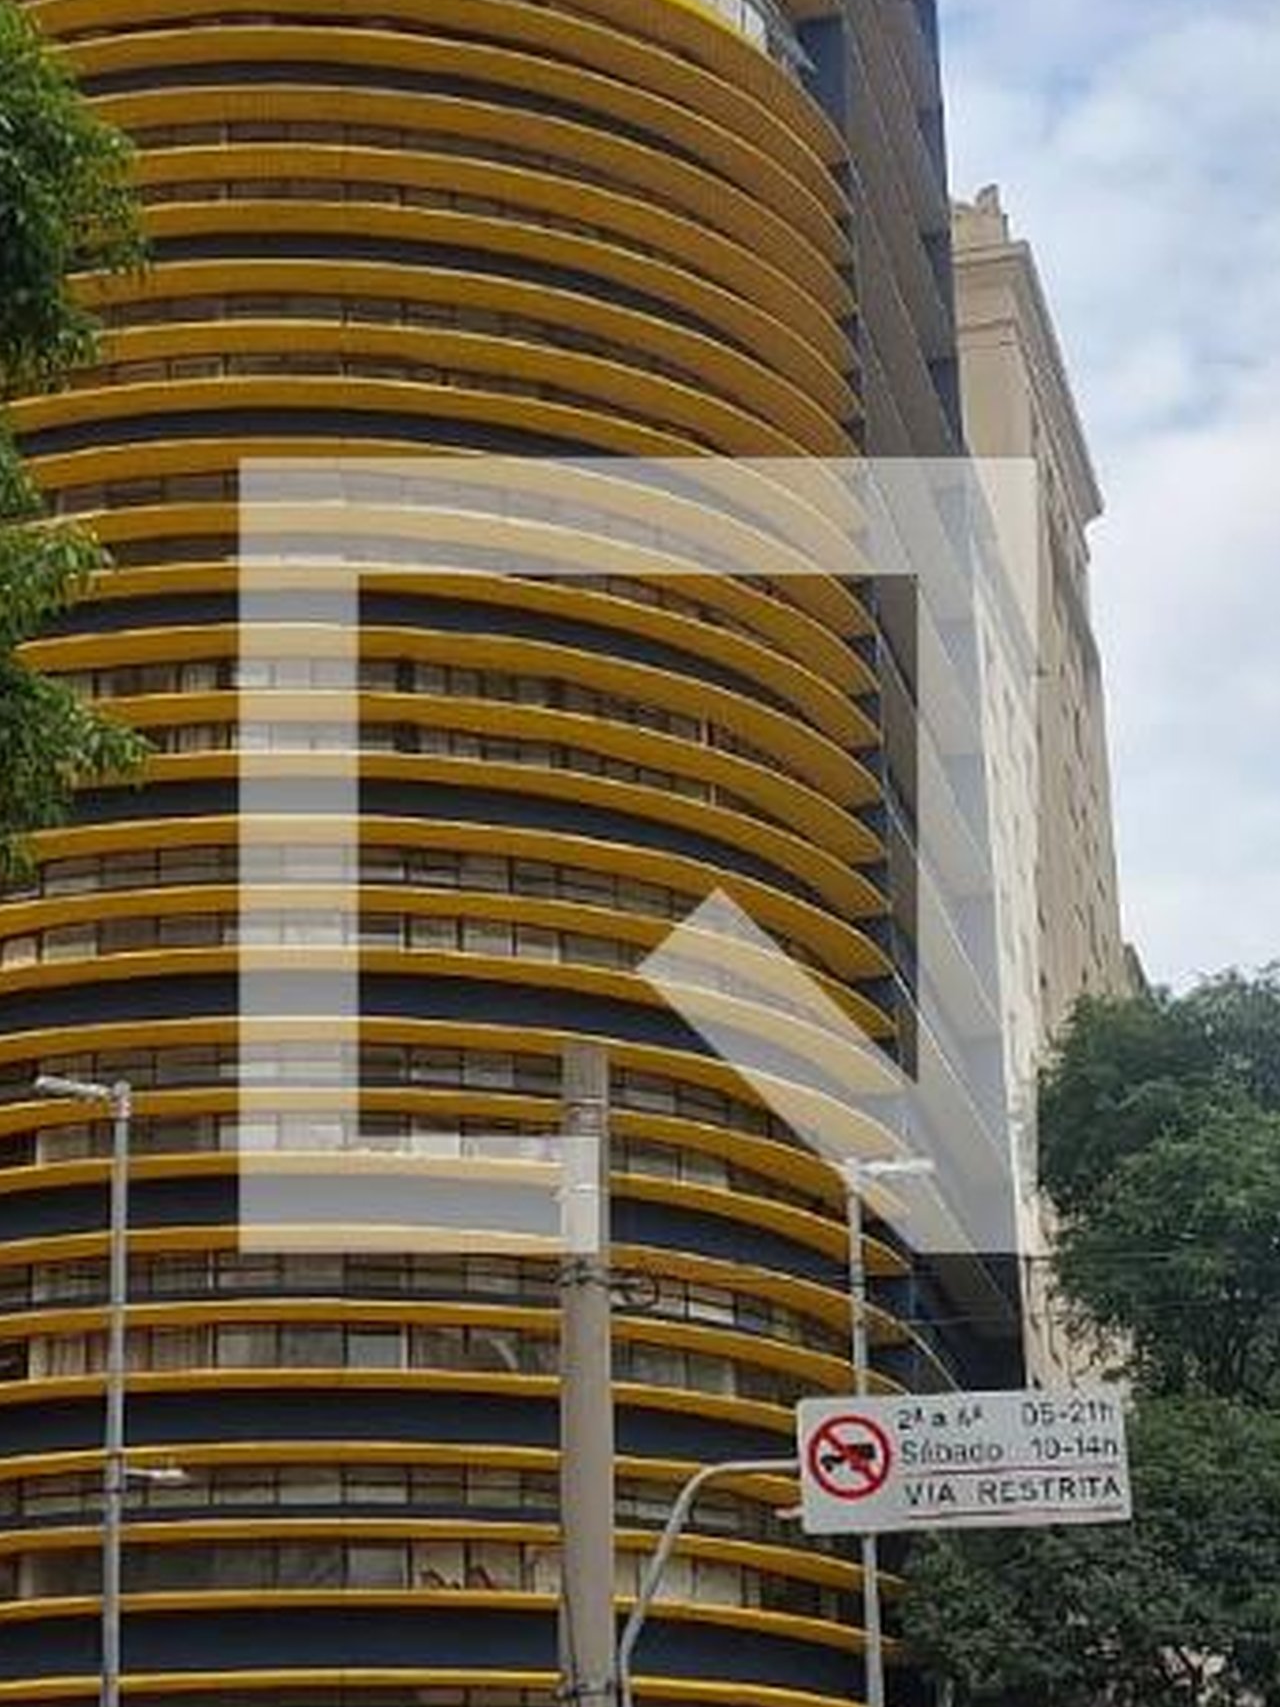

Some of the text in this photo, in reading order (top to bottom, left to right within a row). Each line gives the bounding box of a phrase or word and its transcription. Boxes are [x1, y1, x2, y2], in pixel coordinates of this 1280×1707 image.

[931, 1412, 948, 1427] a
[900, 1437, 1004, 1466] Sábado
[904, 1476, 1122, 1506] VIA RESTRITA
